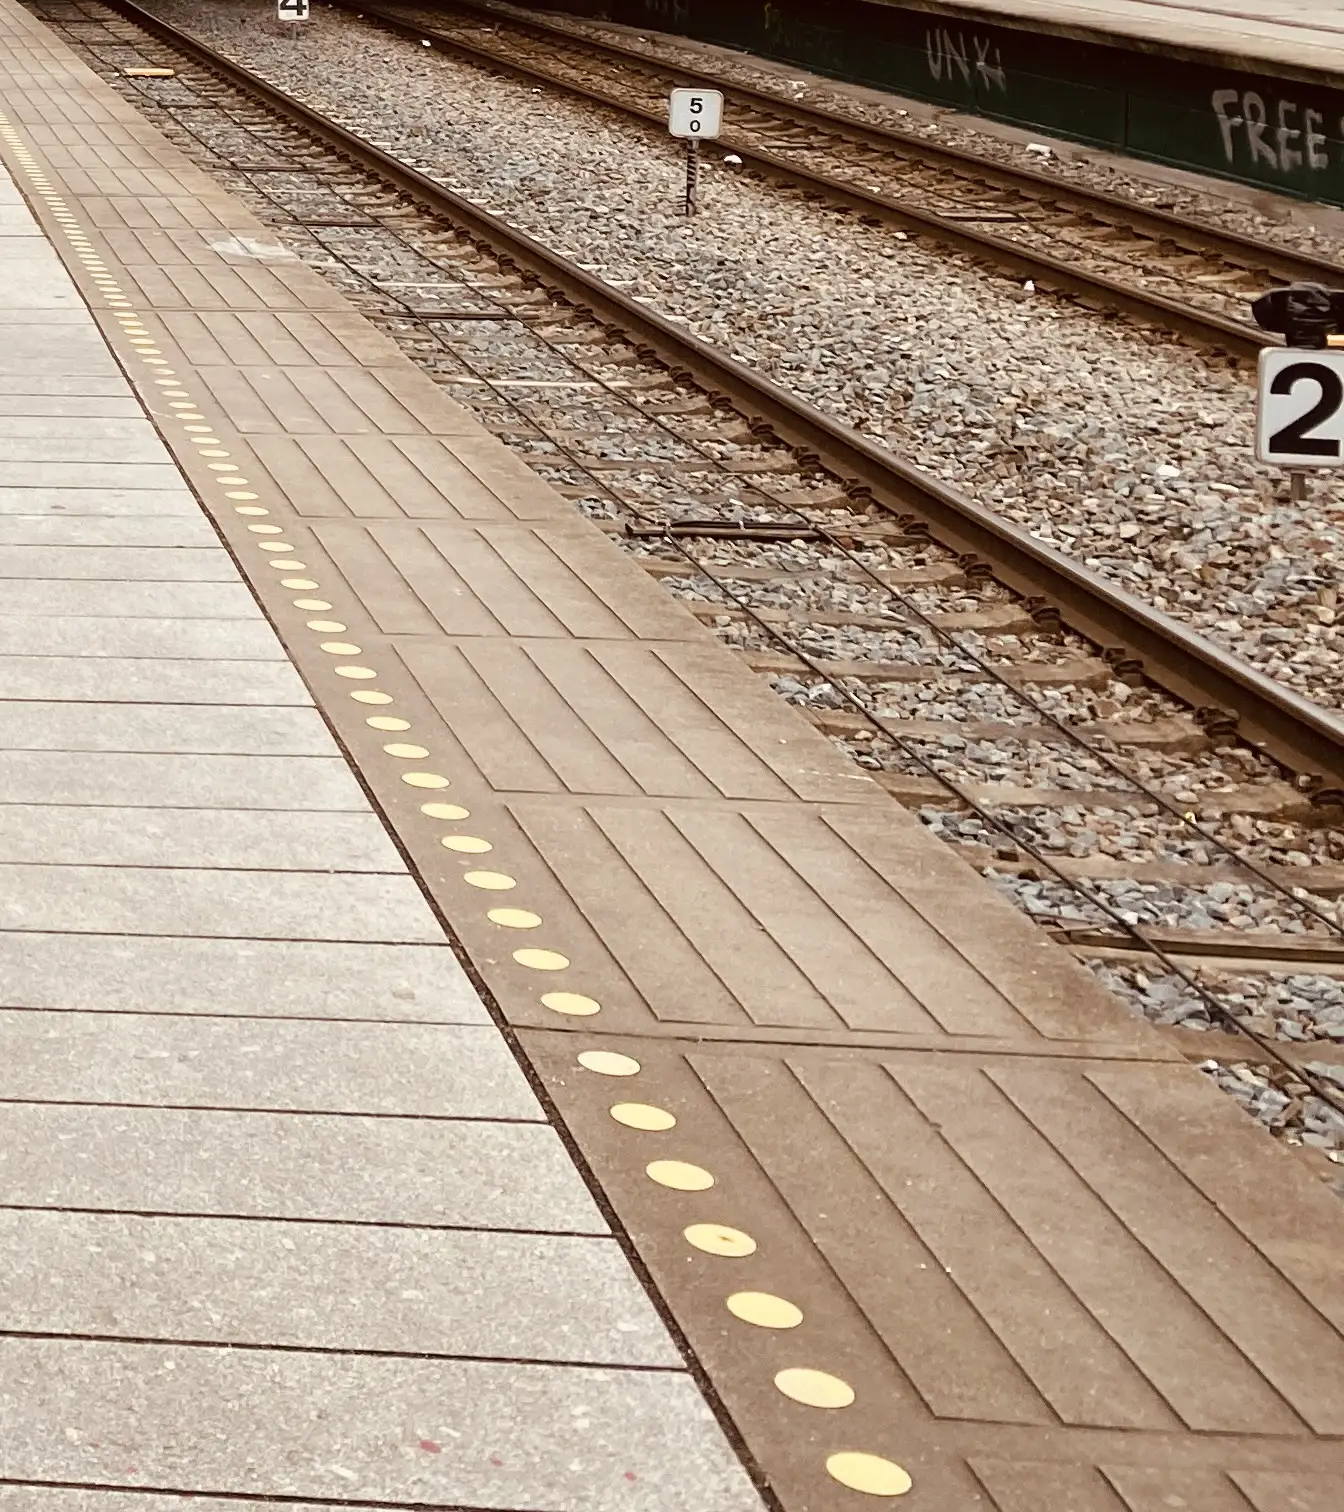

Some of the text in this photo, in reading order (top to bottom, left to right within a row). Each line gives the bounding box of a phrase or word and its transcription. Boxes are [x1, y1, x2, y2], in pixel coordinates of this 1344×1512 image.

[690, 98, 703, 114] 5
[690, 120, 701, 133] 0
[1212, 89, 1328, 172] FREE
[1269, 362, 1344, 457] 2
